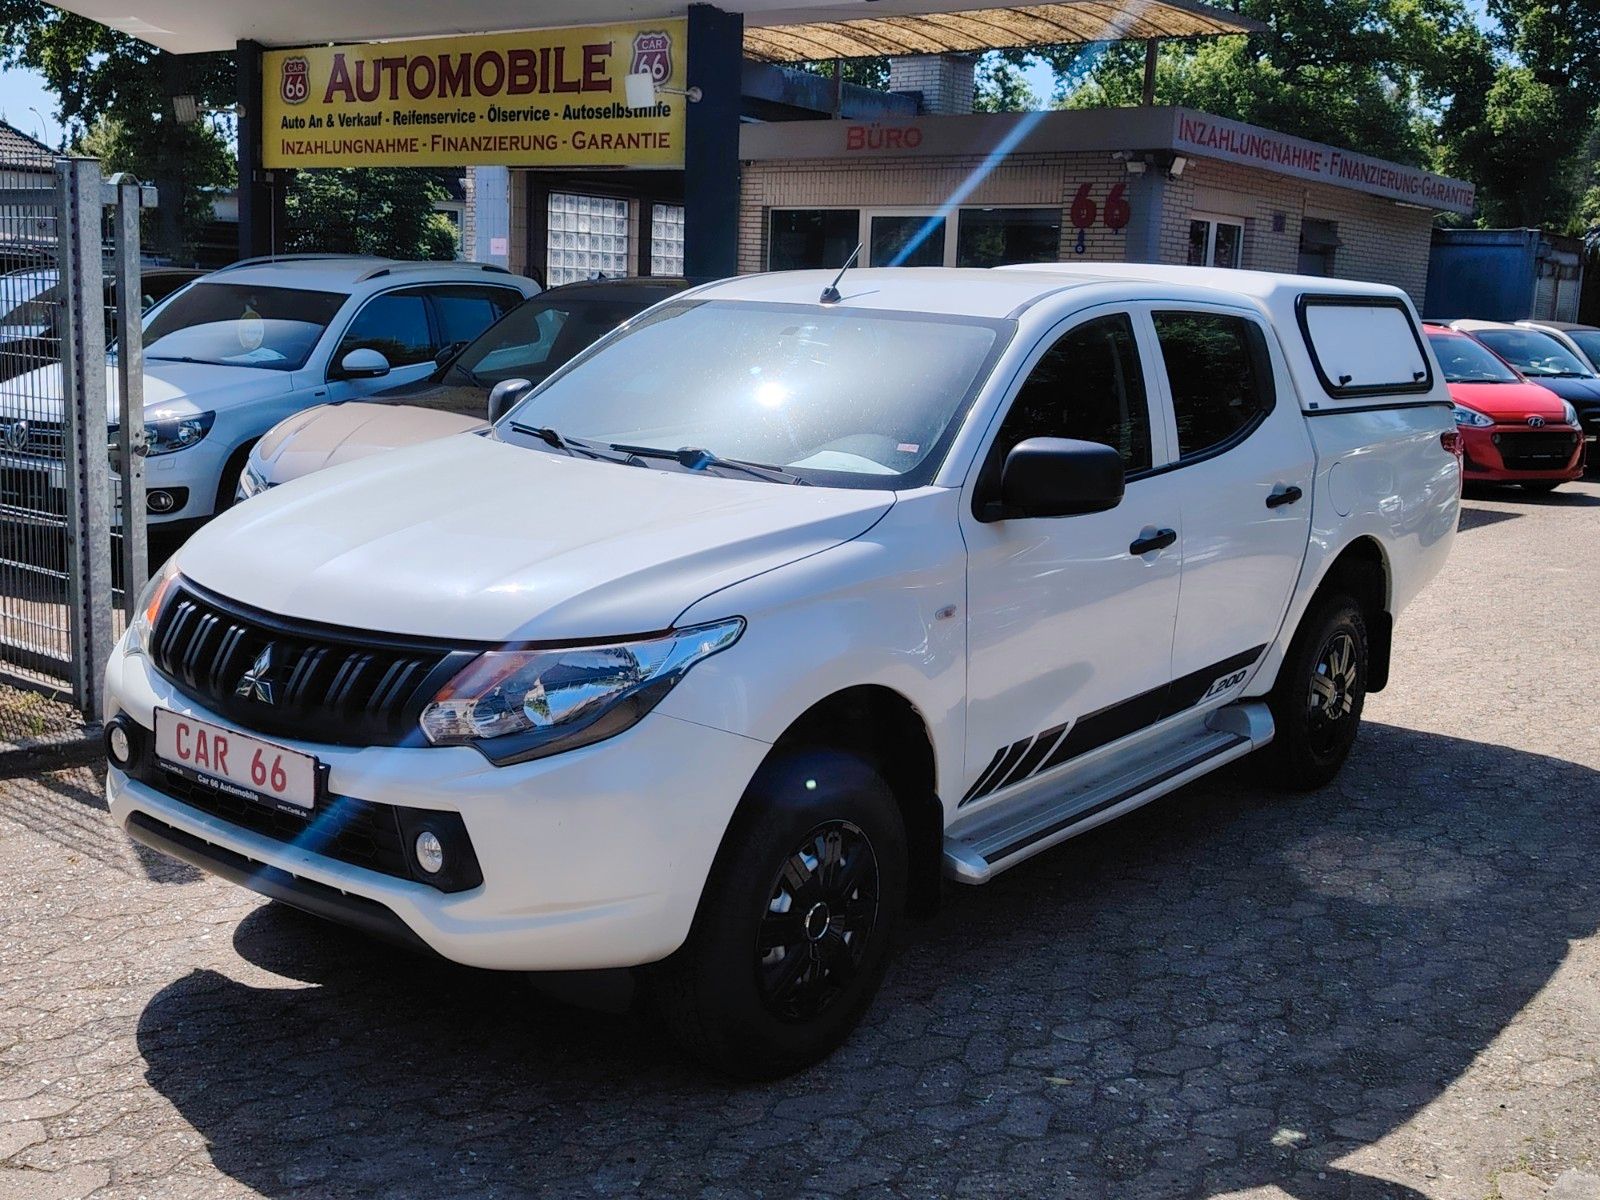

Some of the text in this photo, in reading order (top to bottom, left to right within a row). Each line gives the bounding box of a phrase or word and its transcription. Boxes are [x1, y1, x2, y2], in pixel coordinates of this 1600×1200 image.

[641, 39, 662, 49] CAR
[287, 63, 303, 72] CAR
[323, 41, 612, 103] AUTOMOBILE
[638, 53, 664, 80] 66
[285, 75, 305, 98] 66
[281, 115, 305, 129] Auto
[308, 114, 323, 128] An
[326, 114, 335, 127] &
[338, 111, 383, 127] Verkauf
[393, 109, 476, 126] Reifenservice
[487, 103, 550, 123] Ölservice
[281, 137, 419, 155] INZAHLUNGNAHME
[431, 134, 558, 152] FINANZIERUNG
[571, 131, 670, 150] GARANTIE
[847, 122, 922, 150] BÜRO
[1179, 113, 1323, 172] INZAHLUNGNAHME
[1205, 669, 1247, 698] L200
[175, 722, 287, 793] CAR 66
[197, 774, 211, 786] Car
[219, 781, 259, 802] Automobile
